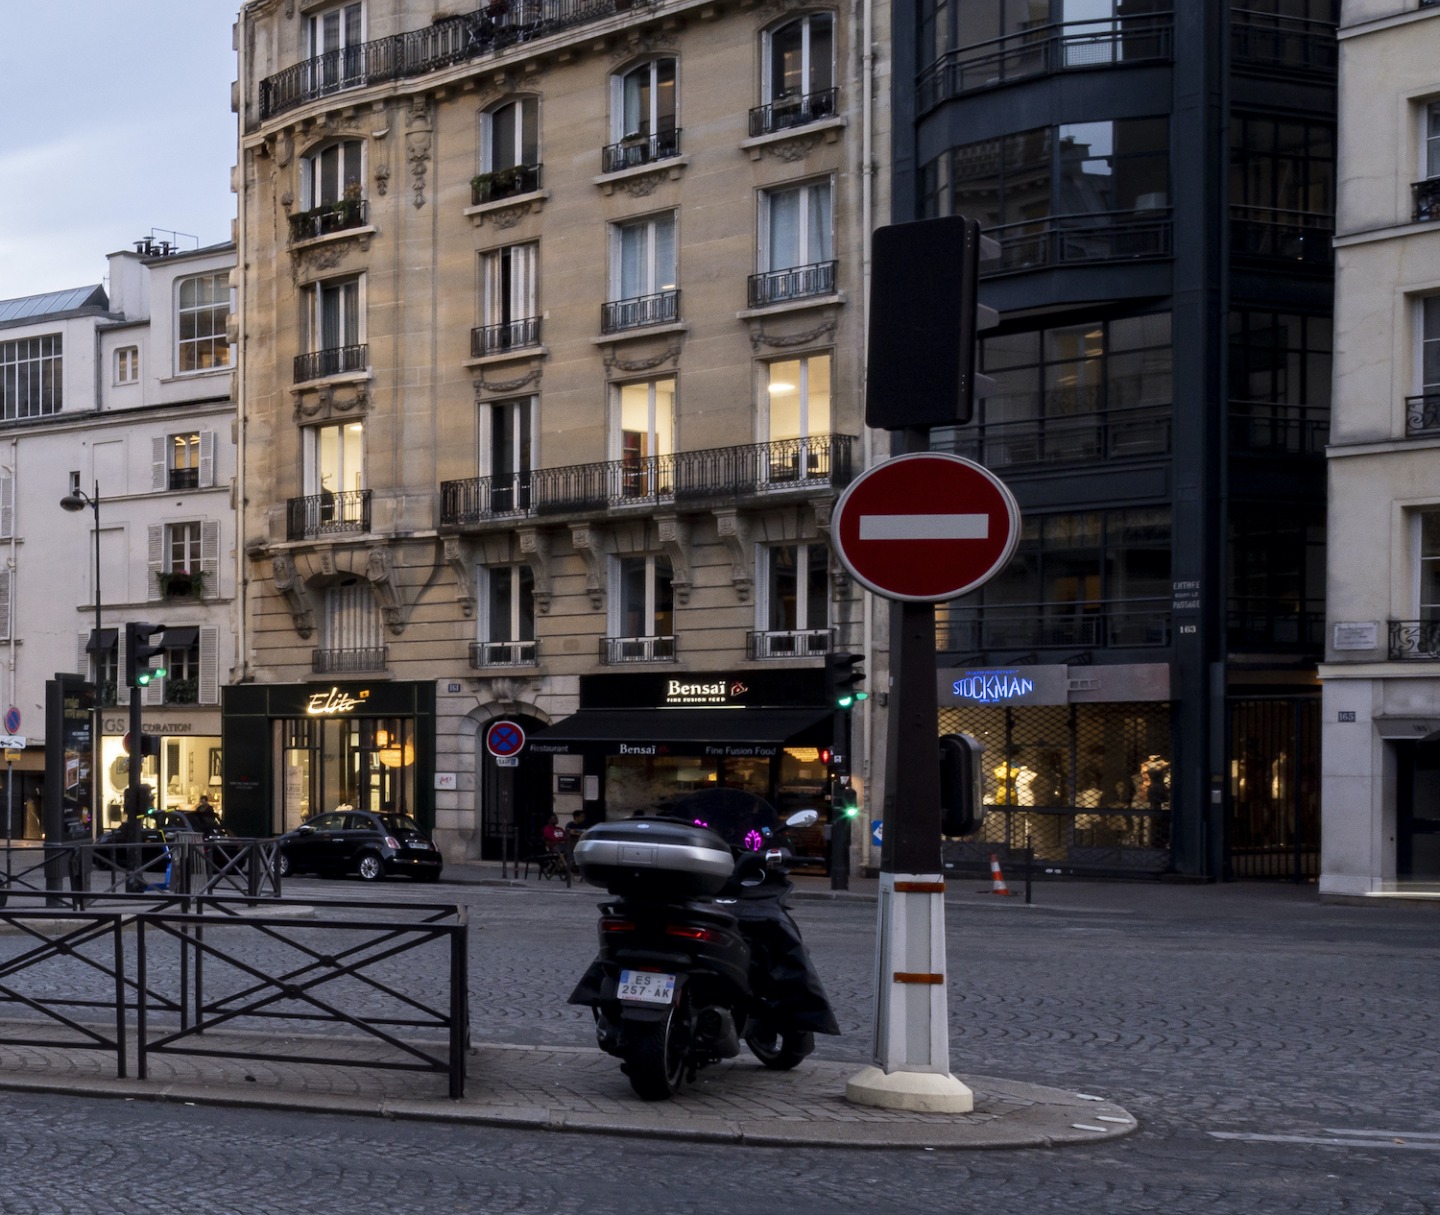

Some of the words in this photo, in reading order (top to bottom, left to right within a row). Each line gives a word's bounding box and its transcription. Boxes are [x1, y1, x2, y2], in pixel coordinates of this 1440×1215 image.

[1180, 625, 1197, 633] 163
[667, 680, 726, 696] Bensaï
[953, 675, 1034, 699] STOCKMAN
[307, 687, 366, 714] Elite
[1339, 712, 1354, 721] 165
[142, 723, 191, 732] CORATION
[530, 744, 569, 752] Restaurant
[620, 744, 656, 755] Bensaï
[705, 746, 723, 754] Fine
[725, 746, 753, 755] Fusion
[754, 746, 777, 755] Food
